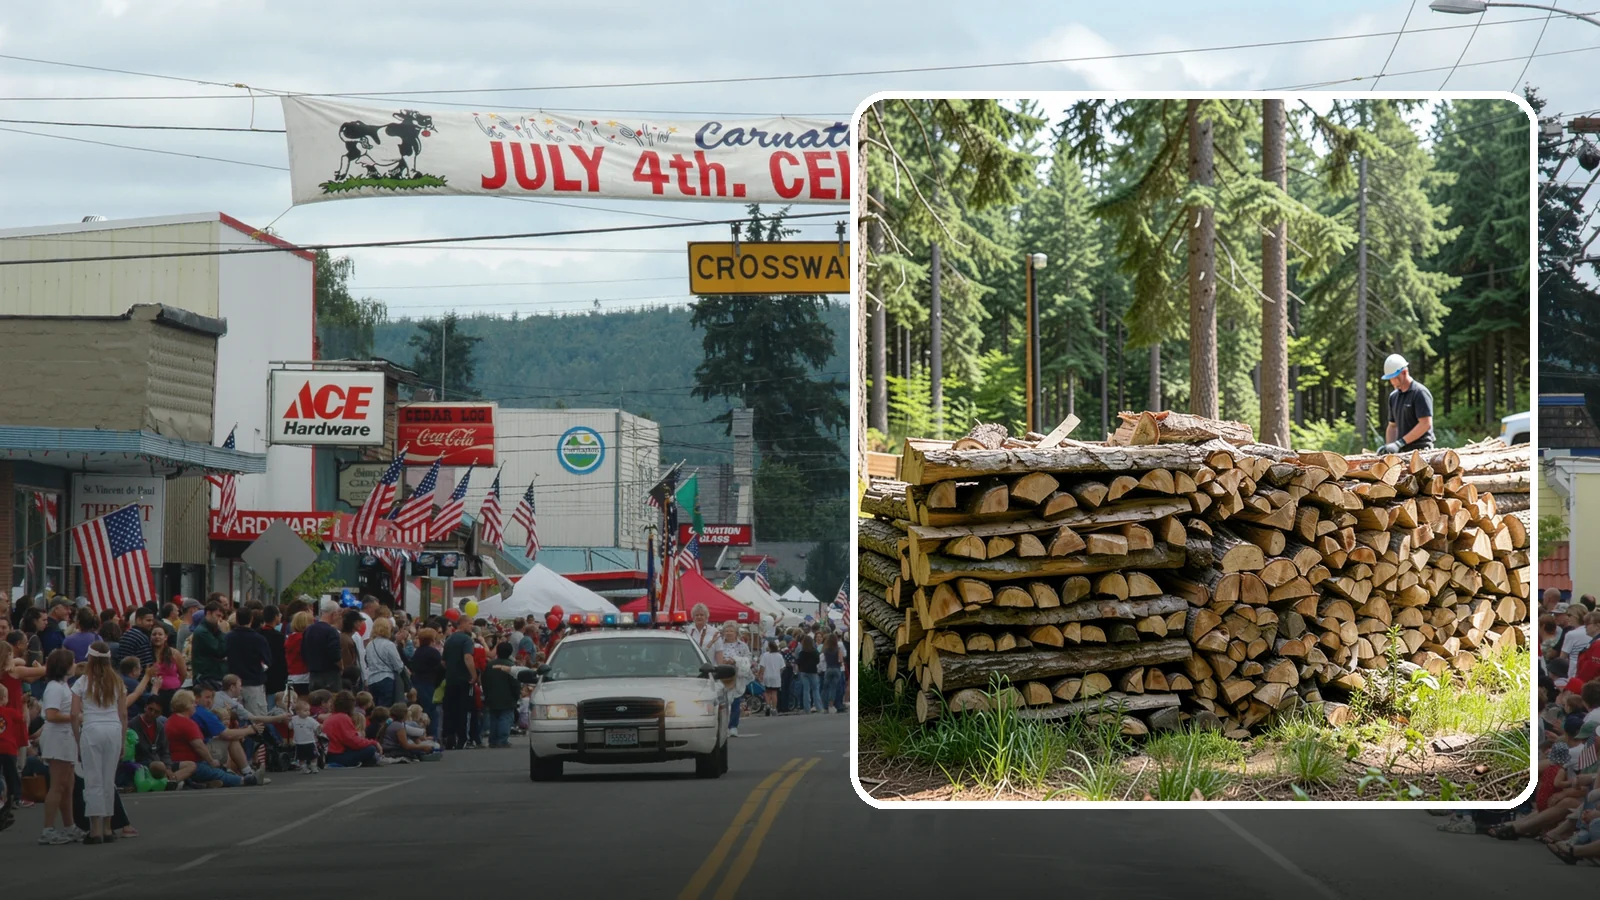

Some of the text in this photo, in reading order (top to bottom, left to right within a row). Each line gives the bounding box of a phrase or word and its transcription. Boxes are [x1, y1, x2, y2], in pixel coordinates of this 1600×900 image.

[481, 141, 605, 193] JULY
[632, 150, 746, 198] 4th.
[697, 254, 850, 280] CROSSWA
[283, 380, 373, 420] ACE
[406, 409, 485, 422] CEDAR LOG
[283, 421, 370, 436] Hardware
[354, 467, 384, 480] Simpl
[96, 485, 124, 495] Vincent
[126, 486, 135, 495] de
[138, 486, 155, 495] Paul
[80, 502, 154, 522] THT
[688, 526, 741, 535] CRNATION
[699, 535, 730, 543] GLASS
